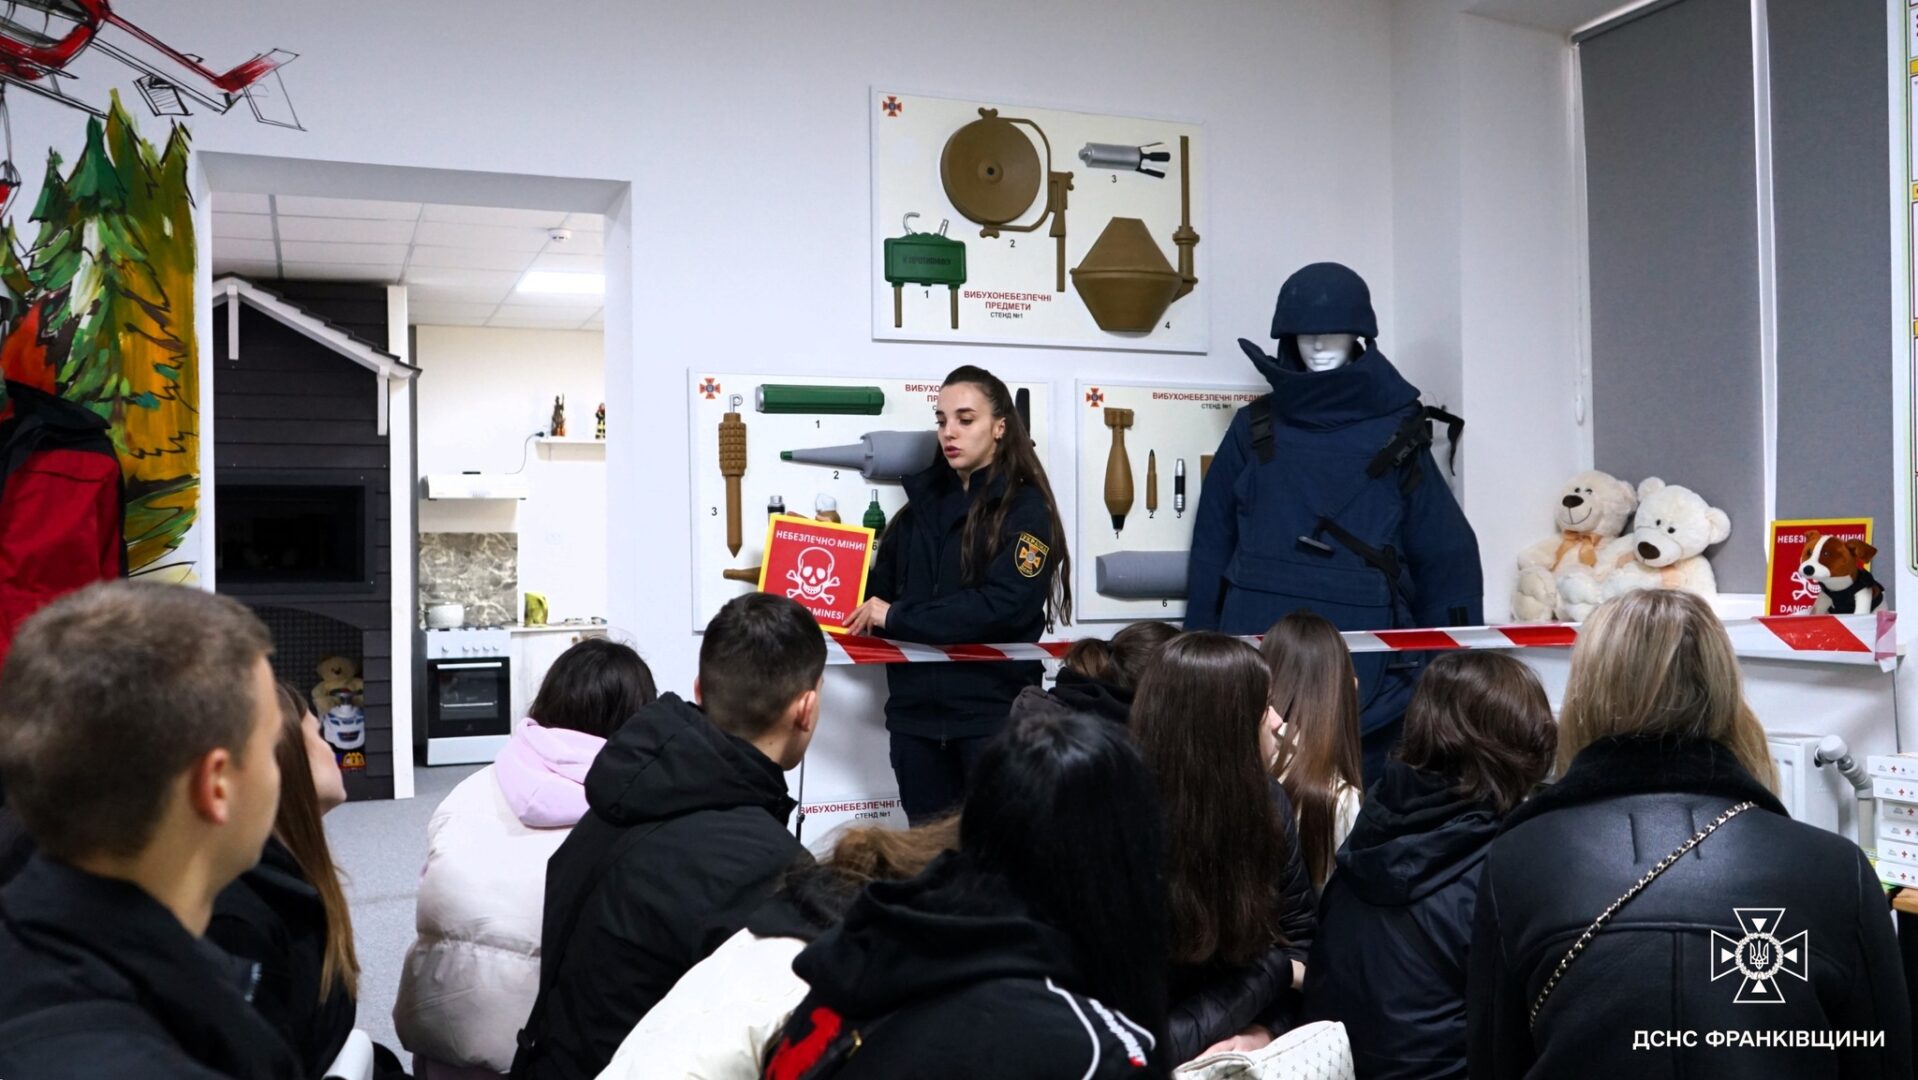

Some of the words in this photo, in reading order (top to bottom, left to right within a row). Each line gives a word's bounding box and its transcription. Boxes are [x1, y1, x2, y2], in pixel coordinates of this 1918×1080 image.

[1111, 175, 1117, 183] 3
[1009, 240, 1016, 248] 2
[964, 290, 1052, 302] ВИБУХОНЕБЕЗПЕЧНІ
[985, 301, 1031, 311] ПРЕДМЕТИ
[1165, 322, 1171, 330] 4
[1152, 392, 1232, 401] ВИБУХОНЕБЕЗПЕЧНІ
[1233, 394, 1259, 402] ПРЕДМ
[815, 420, 821, 429] 1
[833, 471, 840, 480] 2
[711, 507, 718, 517] 3
[1149, 511, 1154, 519] 2
[776, 530, 836, 547] НЕБЕЗПЕЧНО
[837, 539, 866, 552] МІНИ!
[1162, 599, 1168, 608] 6
[812, 607, 845, 620] MINES!
[800, 800, 895, 814] ВИБУХОНЕБЕЗПЕЧНІ
[855, 811, 879, 819] СТЕНД
